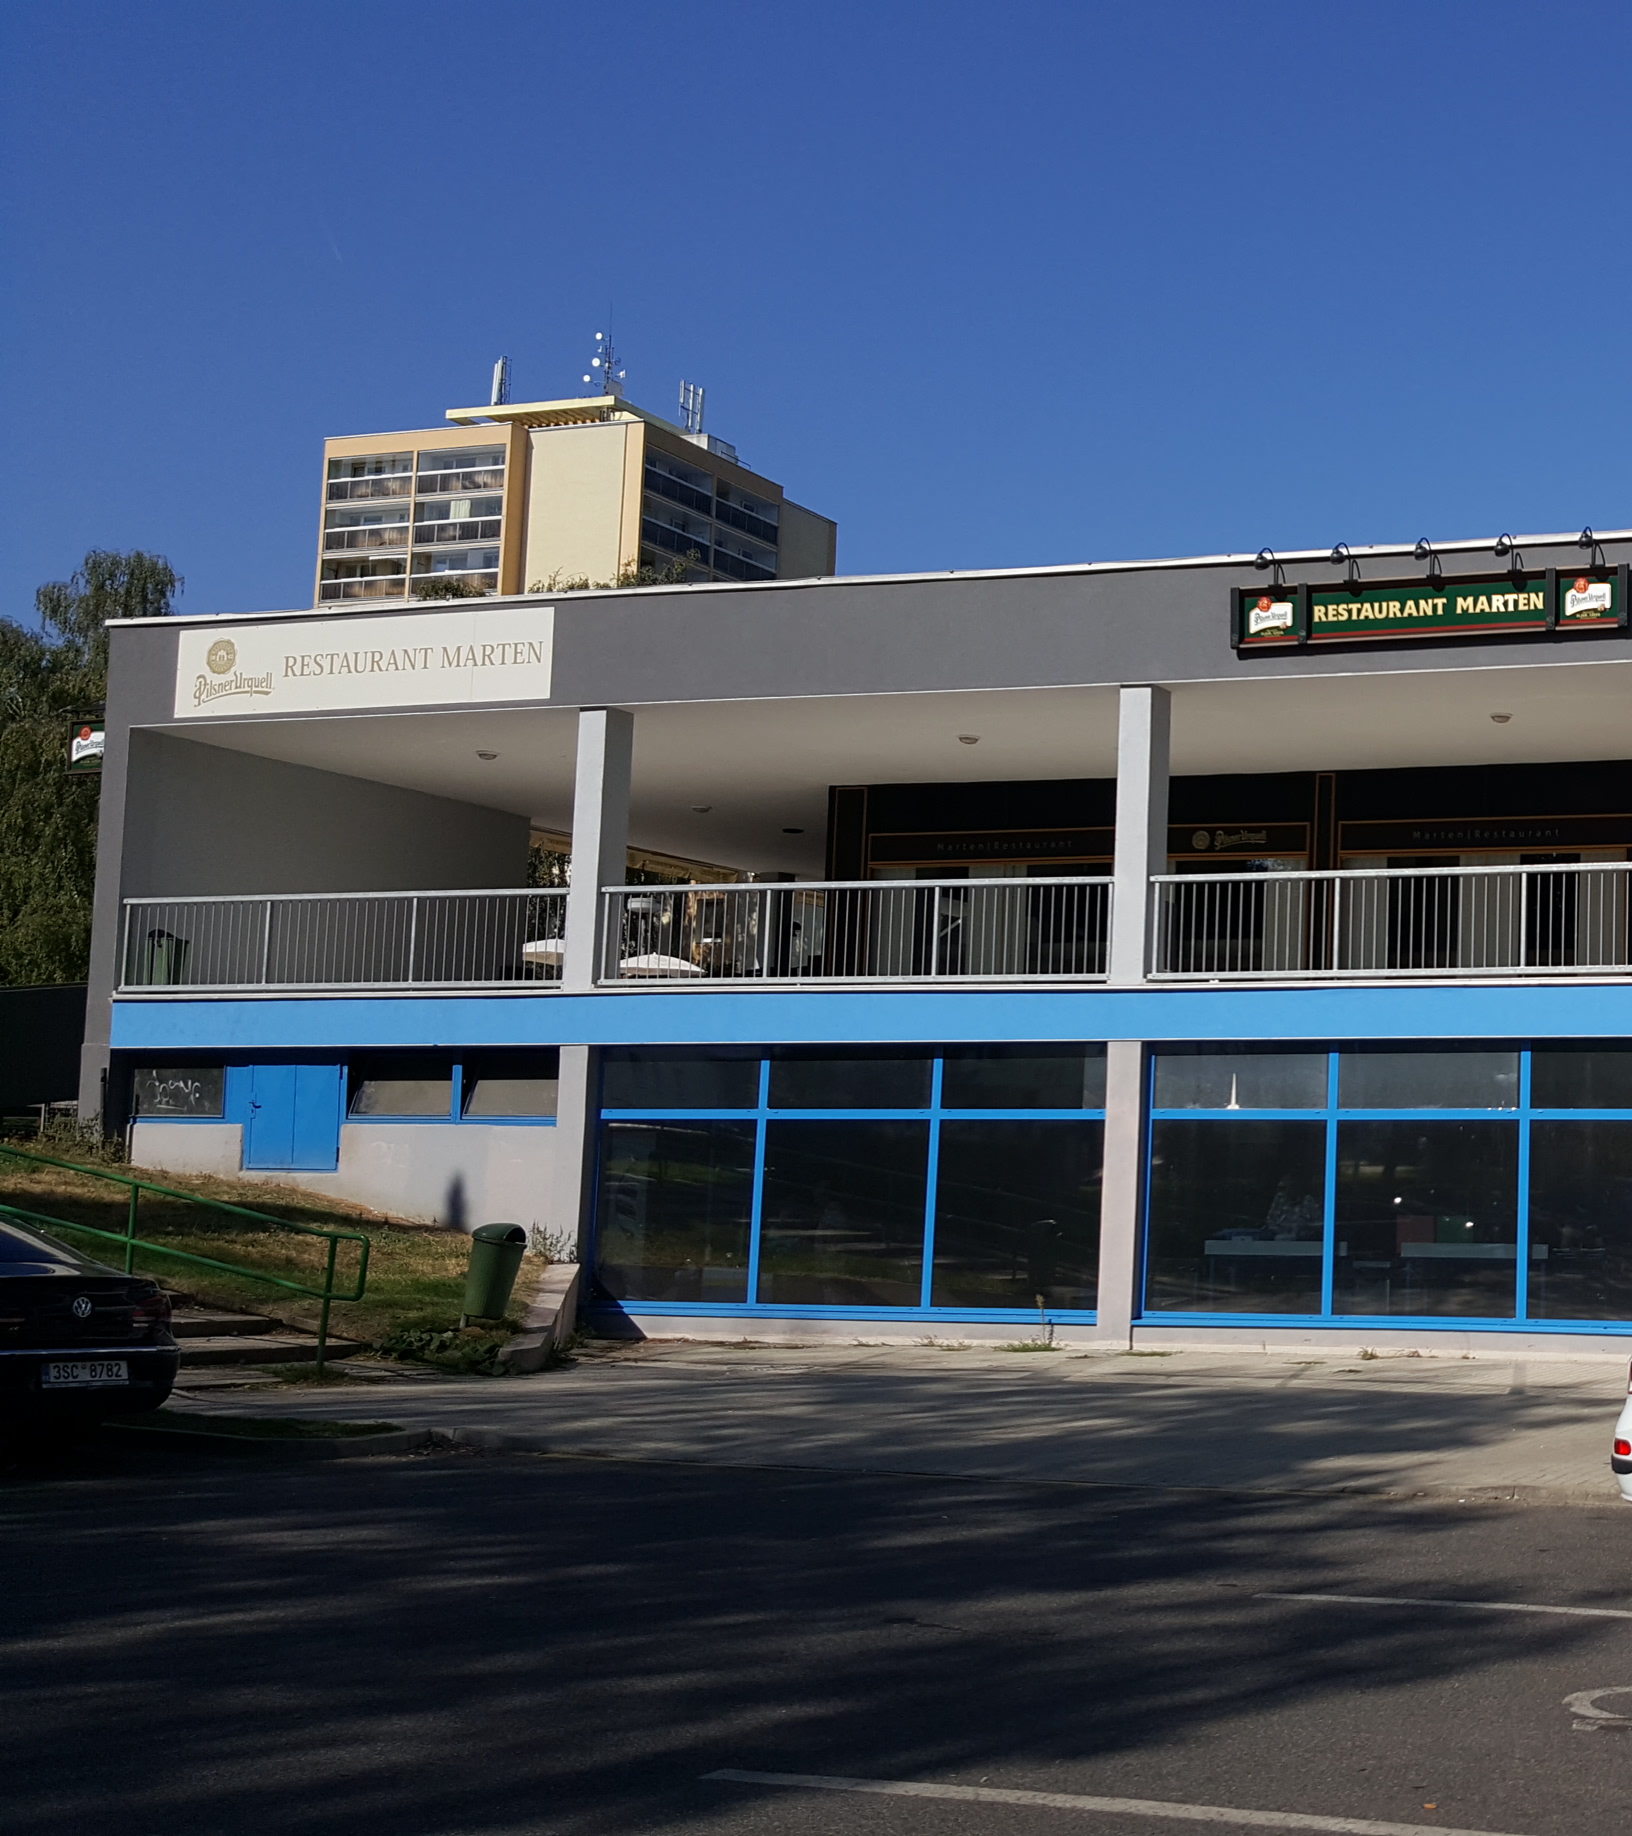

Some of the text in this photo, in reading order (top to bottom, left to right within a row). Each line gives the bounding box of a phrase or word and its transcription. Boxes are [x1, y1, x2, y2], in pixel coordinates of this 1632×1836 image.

[1313, 592, 1544, 622] RESTAURANT MARTEN
[283, 641, 544, 677] RESTAURANT MARTEN
[194, 671, 273, 707] Pilsner Urquell
[53, 1362, 122, 1379] 3SC 8782
